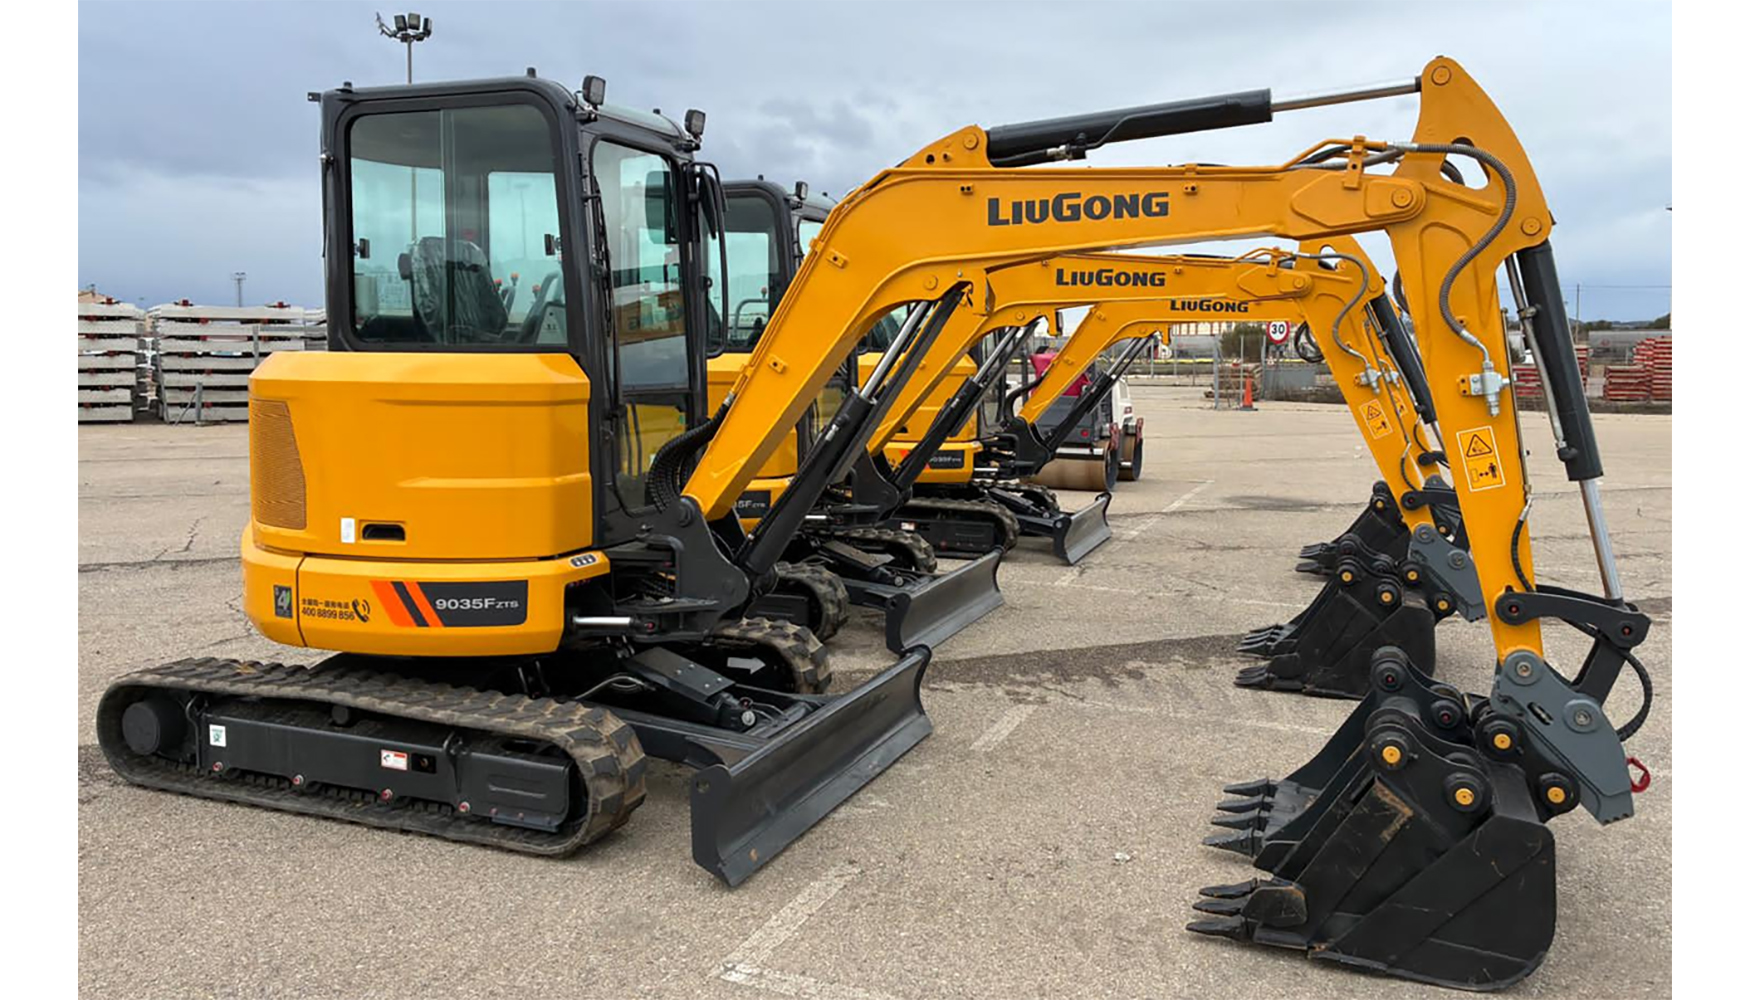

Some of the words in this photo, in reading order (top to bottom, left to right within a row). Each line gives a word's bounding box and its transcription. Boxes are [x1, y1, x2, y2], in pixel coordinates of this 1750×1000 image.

[1271, 323, 1286, 335] 30
[302, 606, 316, 617] 400
[317, 608, 337, 619] 8899
[338, 610, 355, 621] 856
